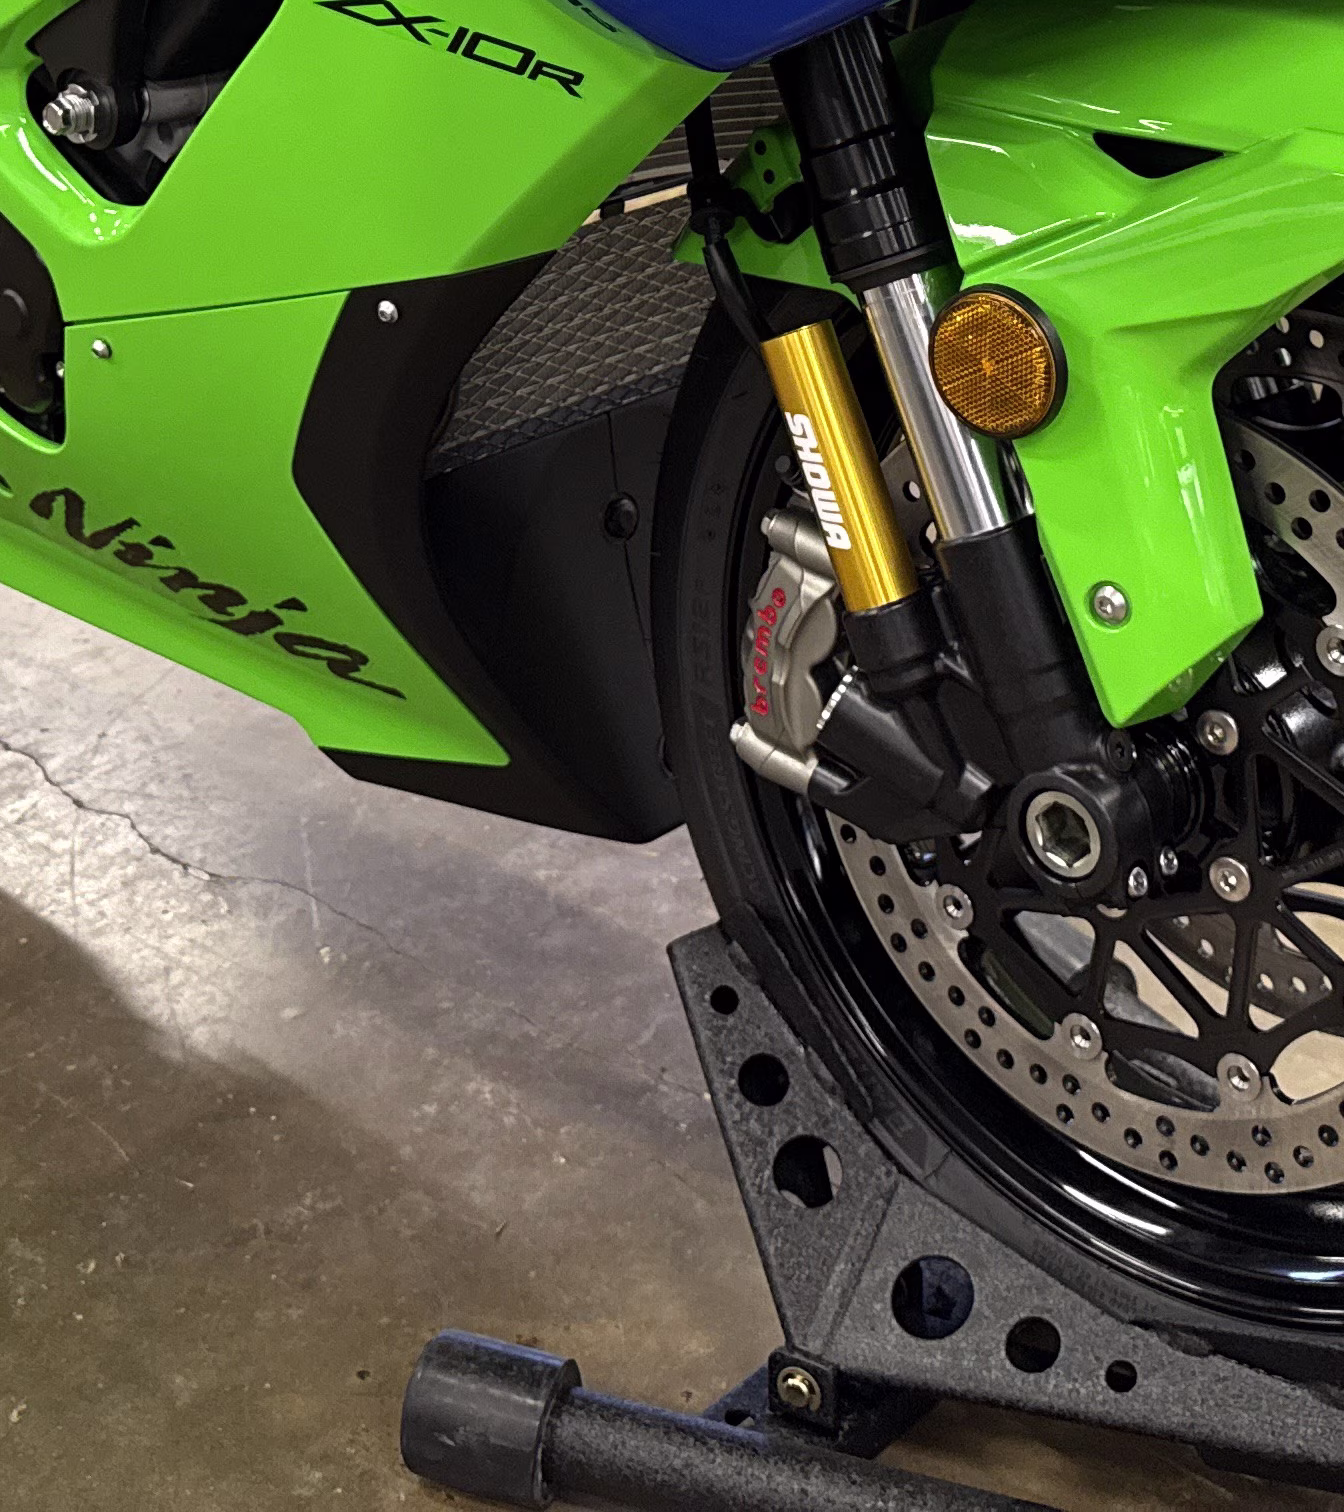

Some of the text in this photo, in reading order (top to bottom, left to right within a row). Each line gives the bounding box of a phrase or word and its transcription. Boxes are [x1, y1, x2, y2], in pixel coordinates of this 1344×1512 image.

[784, 411, 851, 552] SHOWA
[28, 485, 408, 701] Ninja
[749, 586, 787, 718] brembo
